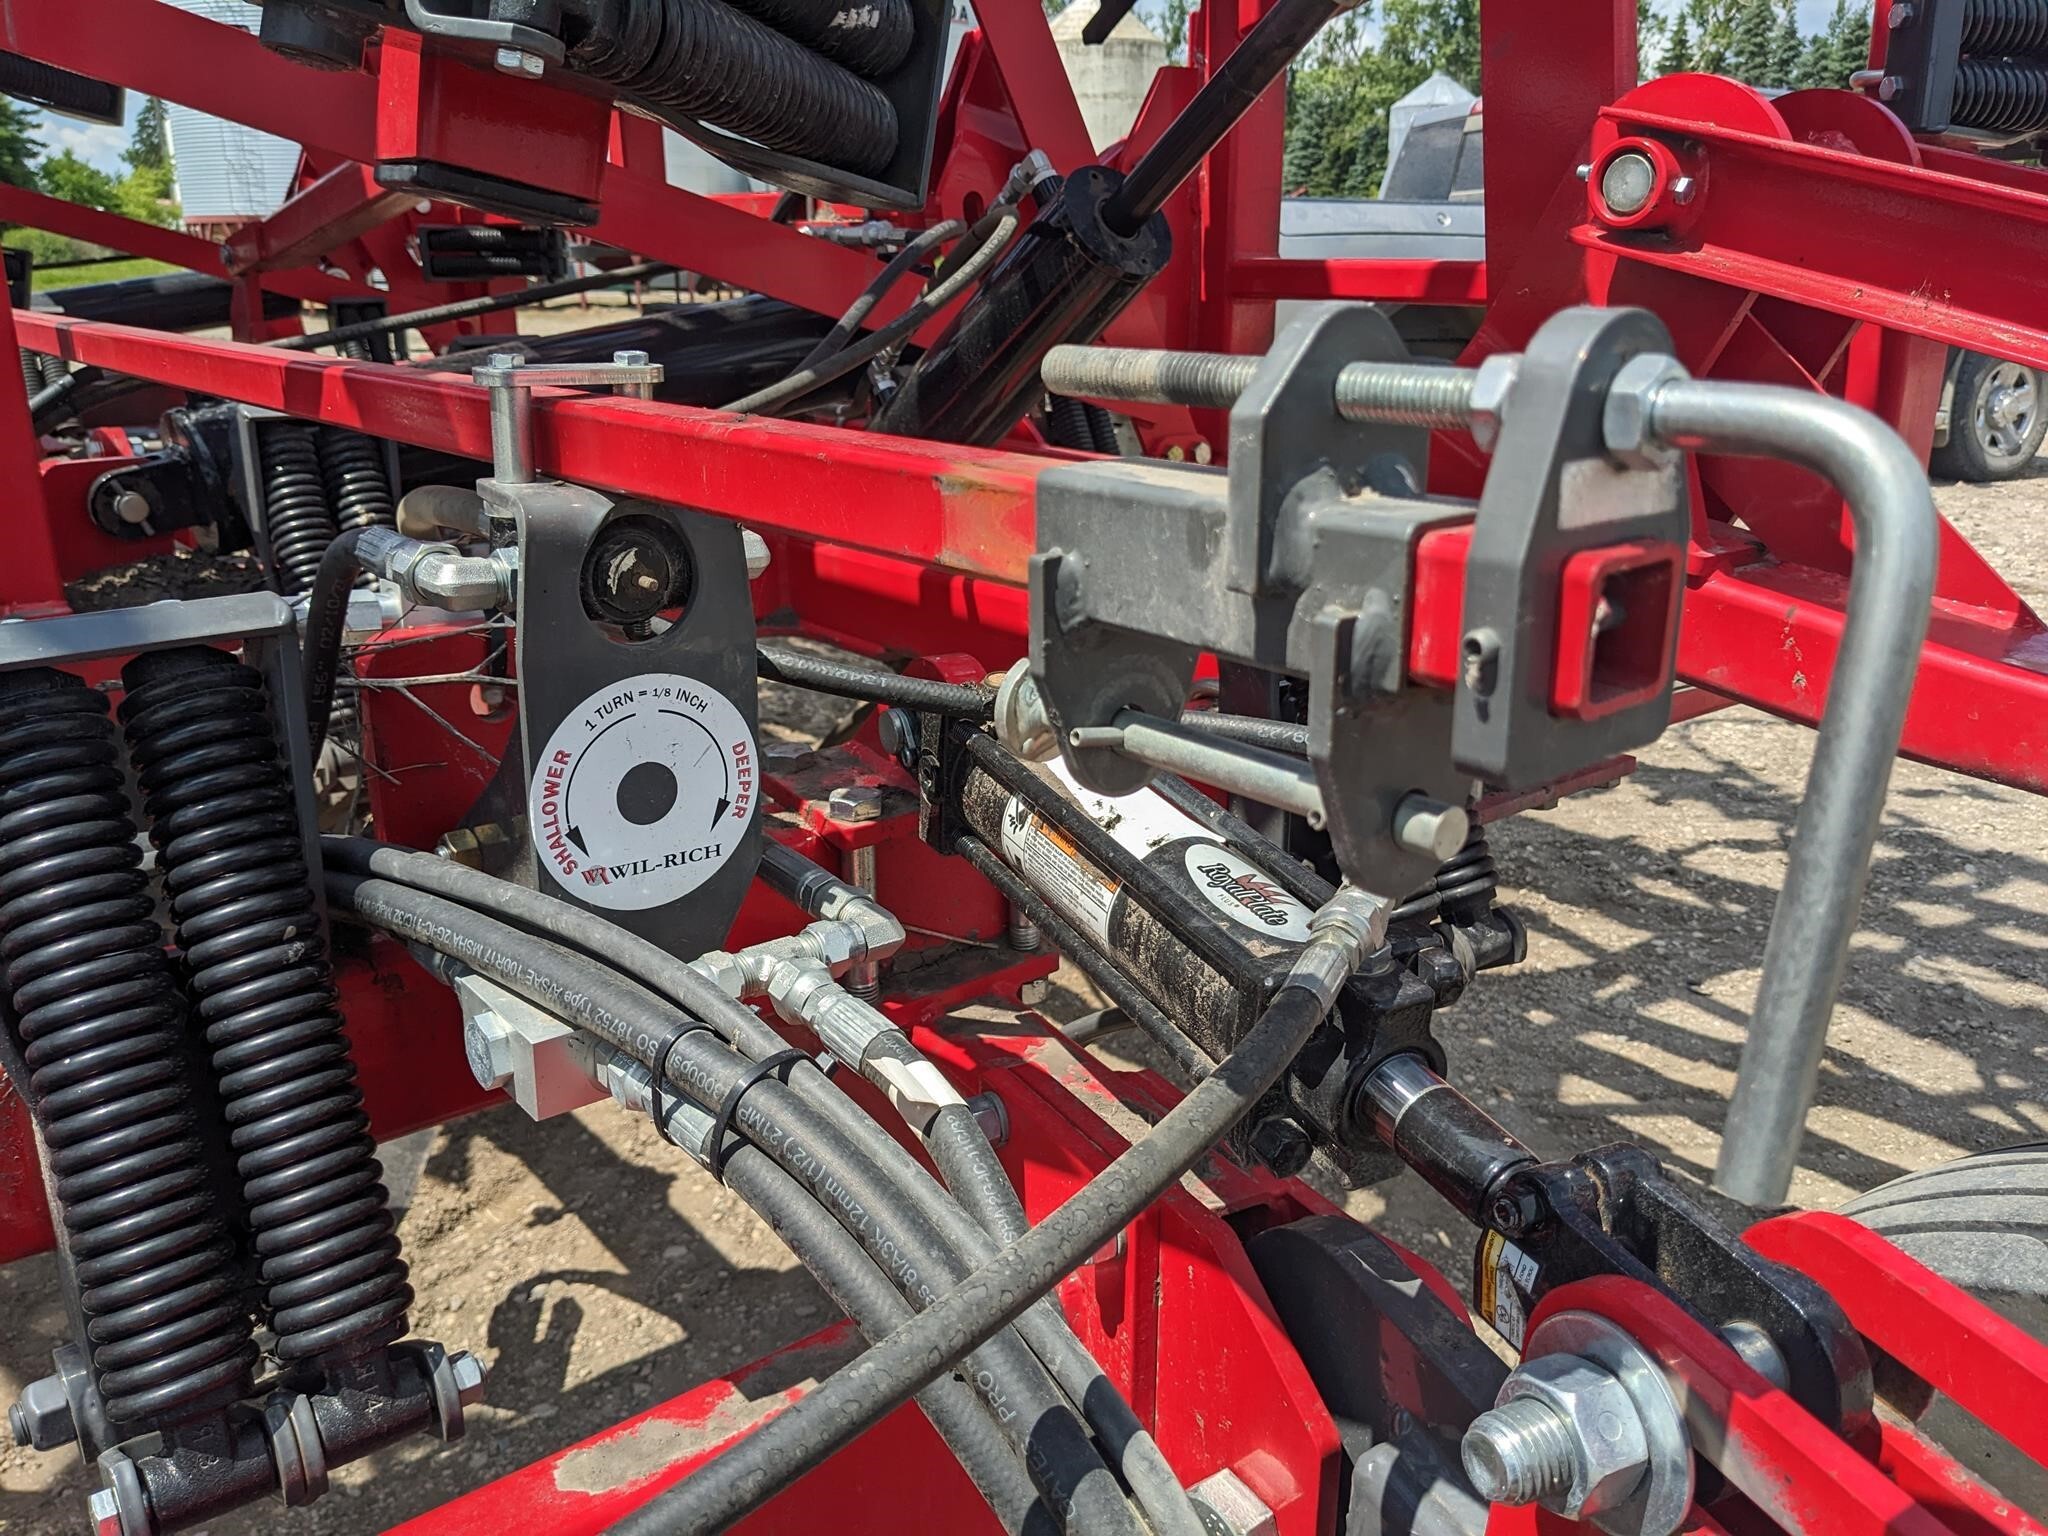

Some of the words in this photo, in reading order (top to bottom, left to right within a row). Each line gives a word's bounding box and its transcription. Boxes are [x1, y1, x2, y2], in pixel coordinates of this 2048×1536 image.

[585, 719, 597, 731] 1
[594, 690, 634, 721] TURN
[652, 687, 671, 699] 1/8
[675, 688, 708, 714] INCH
[731, 741, 753, 820] DEEPER
[541, 750, 579, 876] SHALLOWER
[609, 843, 722, 880] WIL-RICH
[1197, 861, 1288, 925] RoyalPlate
[451, 932, 483, 957] MSHA
[483, 947, 524, 977] 100R17
[562, 989, 593, 1017] Type
[592, 1006, 634, 1040] 18752
[634, 1032, 659, 1056] SO
[736, 1101, 784, 1144] 21MP
[825, 1180, 871, 1230] 12mm
[991, 1206, 1021, 1247] SHA
